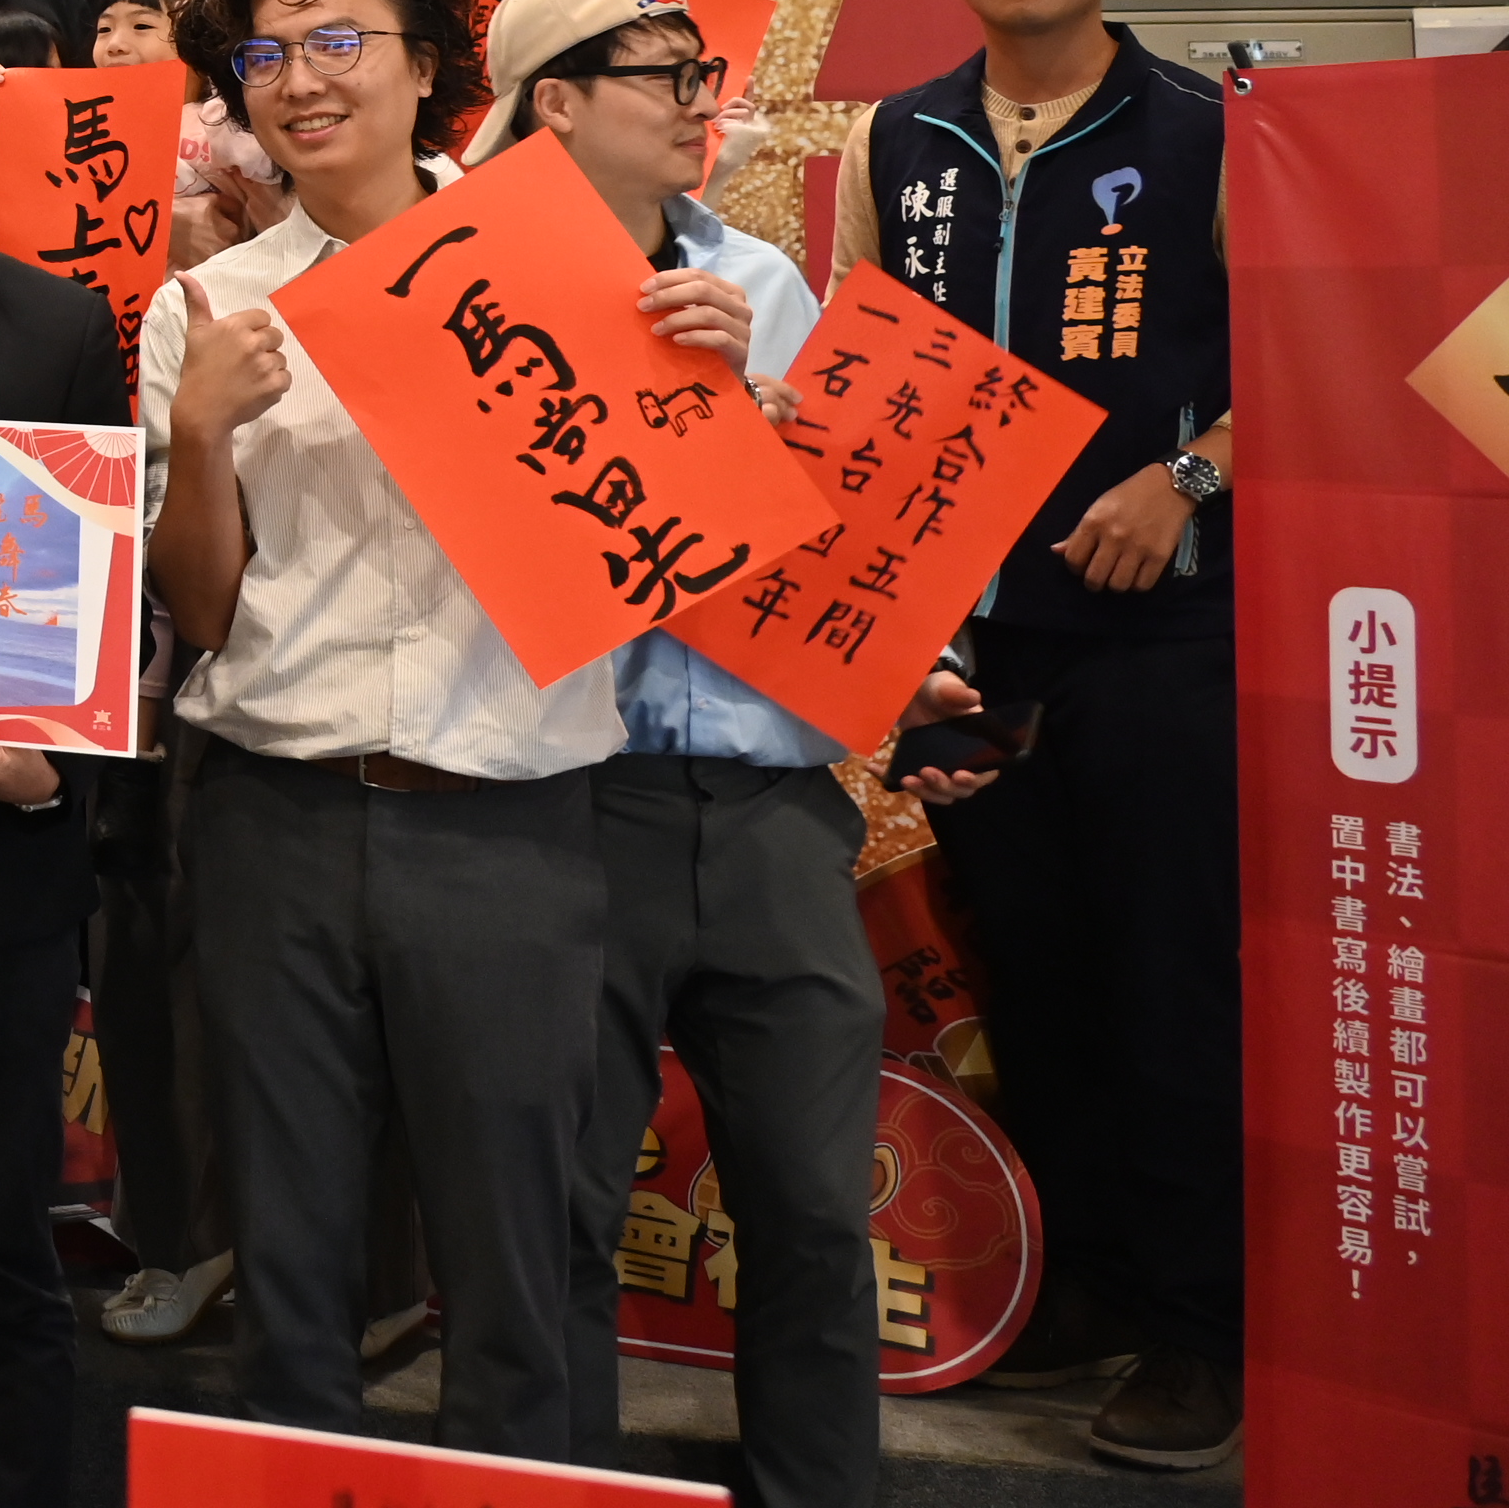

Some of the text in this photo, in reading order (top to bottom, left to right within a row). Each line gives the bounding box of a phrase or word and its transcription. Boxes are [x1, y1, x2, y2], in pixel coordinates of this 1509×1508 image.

[900, 180, 935, 279] 陳永
[932, 167, 960, 304] 選服副主任
[1060, 246, 1109, 362] 黃建賓
[1111, 245, 1149, 360] 立法委員
[1347, 609, 1399, 761] 小提示
[1329, 814, 1374, 1300] 置中書寫後續製作更容易！
[1384, 819, 1432, 1267] 書法、繪畫都可以嘗試，
